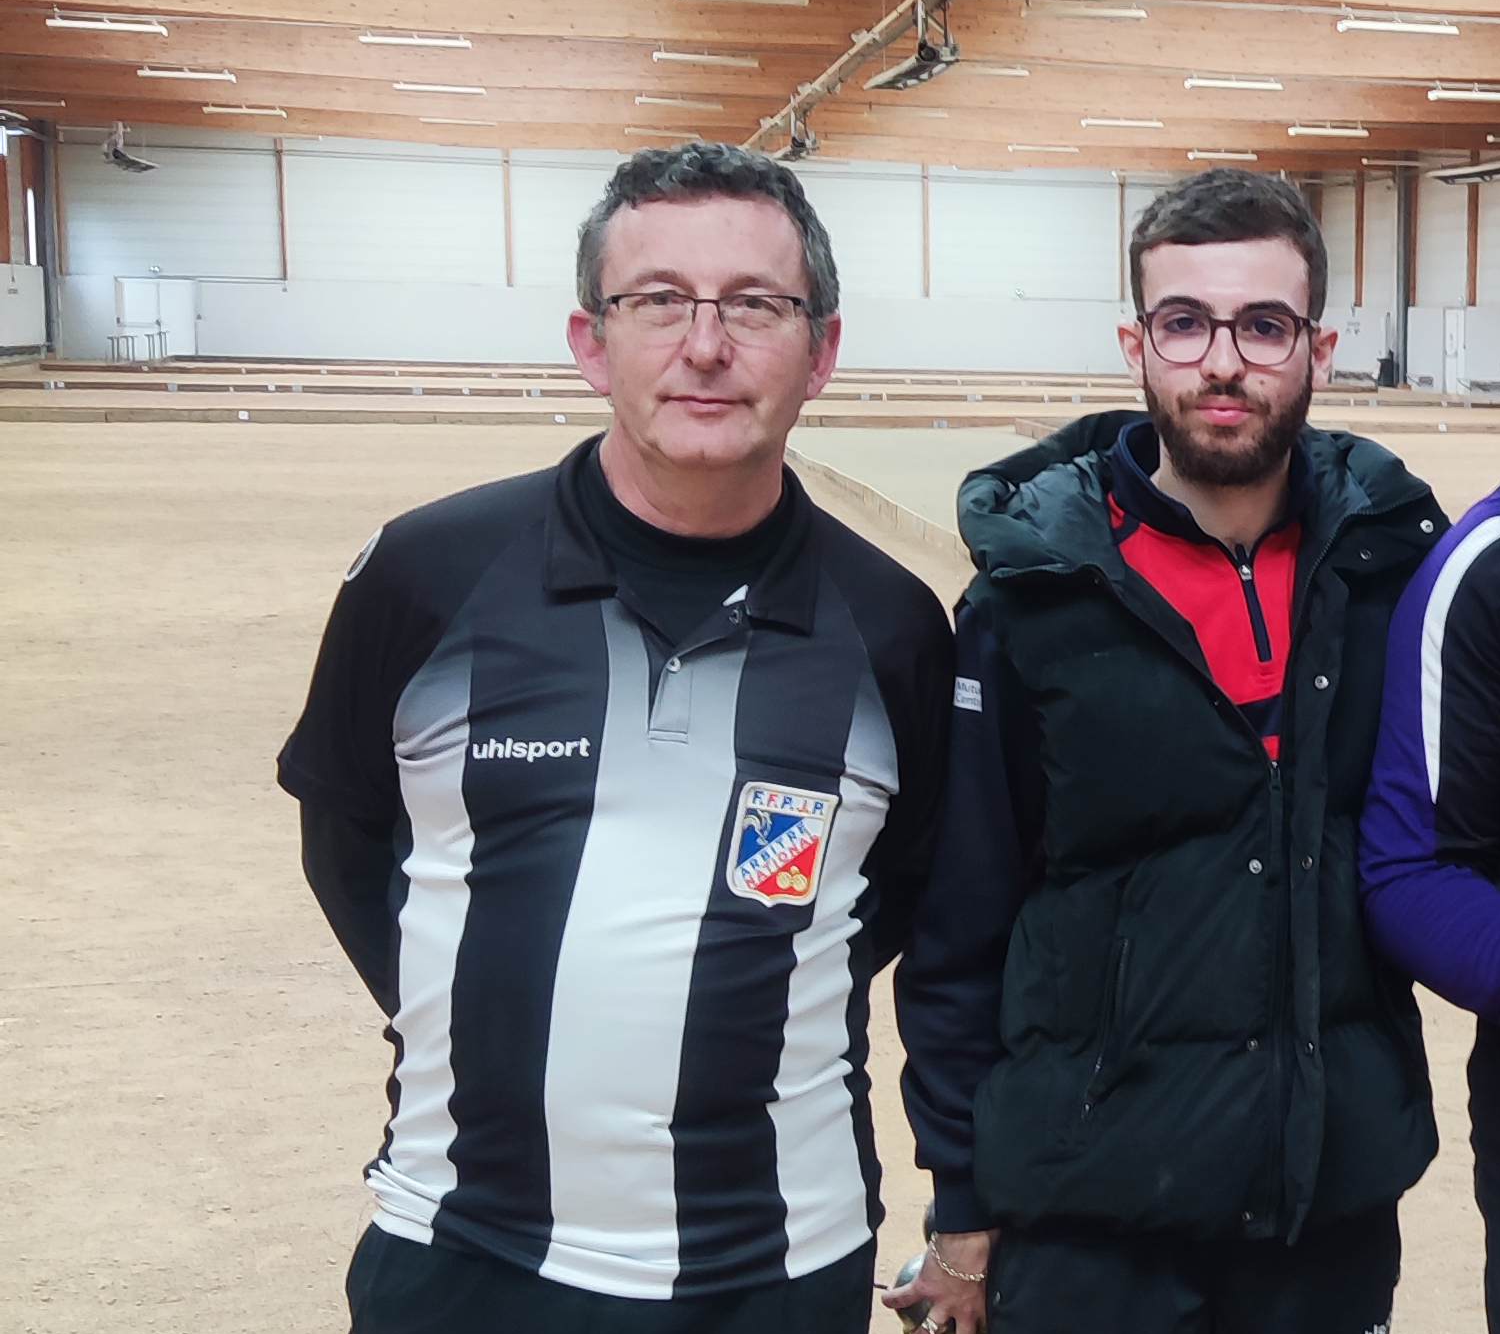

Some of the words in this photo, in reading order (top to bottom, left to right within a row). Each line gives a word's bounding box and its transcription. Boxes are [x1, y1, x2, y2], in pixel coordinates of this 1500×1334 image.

[472, 737, 591, 763] uhlsport
[740, 820, 809, 879] ARBITRE
[744, 828, 822, 891] NATIONAL
